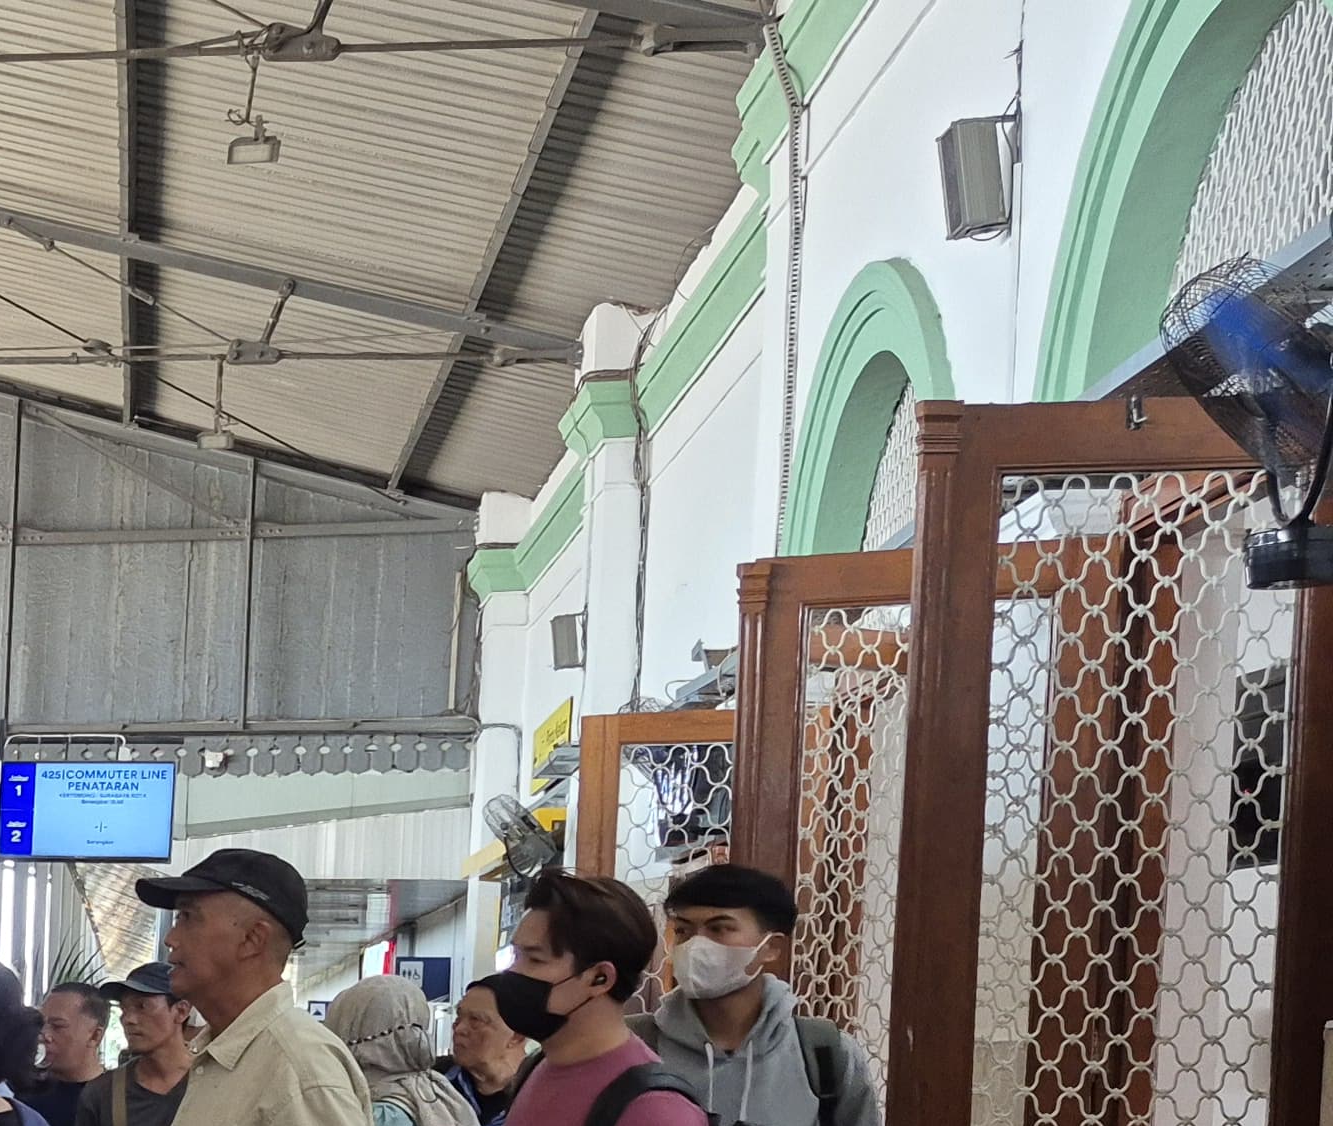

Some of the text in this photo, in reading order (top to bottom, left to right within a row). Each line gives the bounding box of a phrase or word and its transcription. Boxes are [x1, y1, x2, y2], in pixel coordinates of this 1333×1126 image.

[141, 770, 168, 780] LINE
[15, 785, 22, 796] 1
[68, 781, 139, 791] PENATARAN
[11, 830, 22, 843] 2
